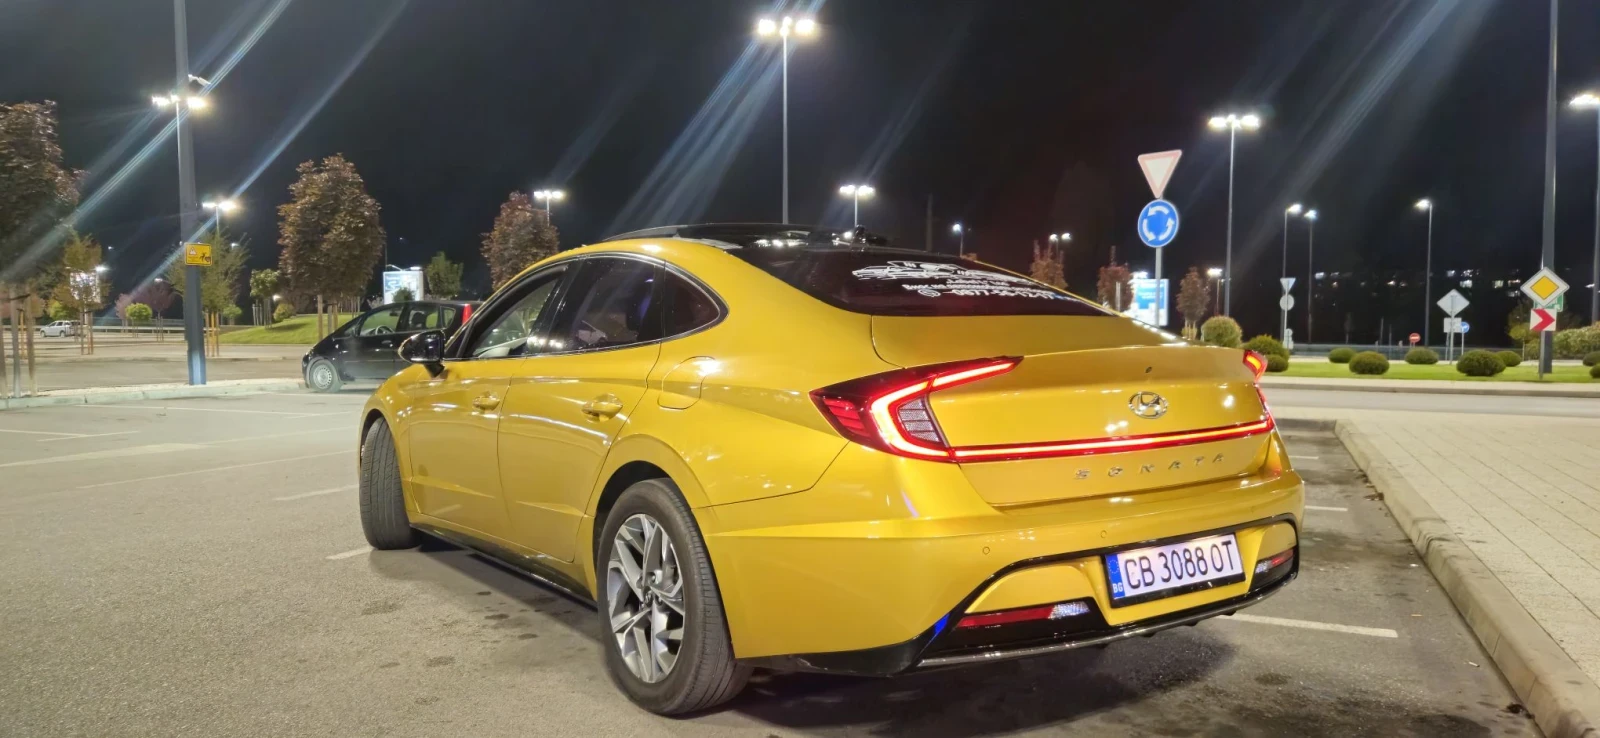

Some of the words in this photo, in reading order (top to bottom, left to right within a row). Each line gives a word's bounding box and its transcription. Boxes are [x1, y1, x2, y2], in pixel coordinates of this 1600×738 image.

[1074, 452, 1225, 480] SONATA
[1124, 556, 1155, 590] CB
[1158, 546, 1209, 583] 3088
[1210, 540, 1235, 573] OT
[1112, 581, 1124, 594] BG
